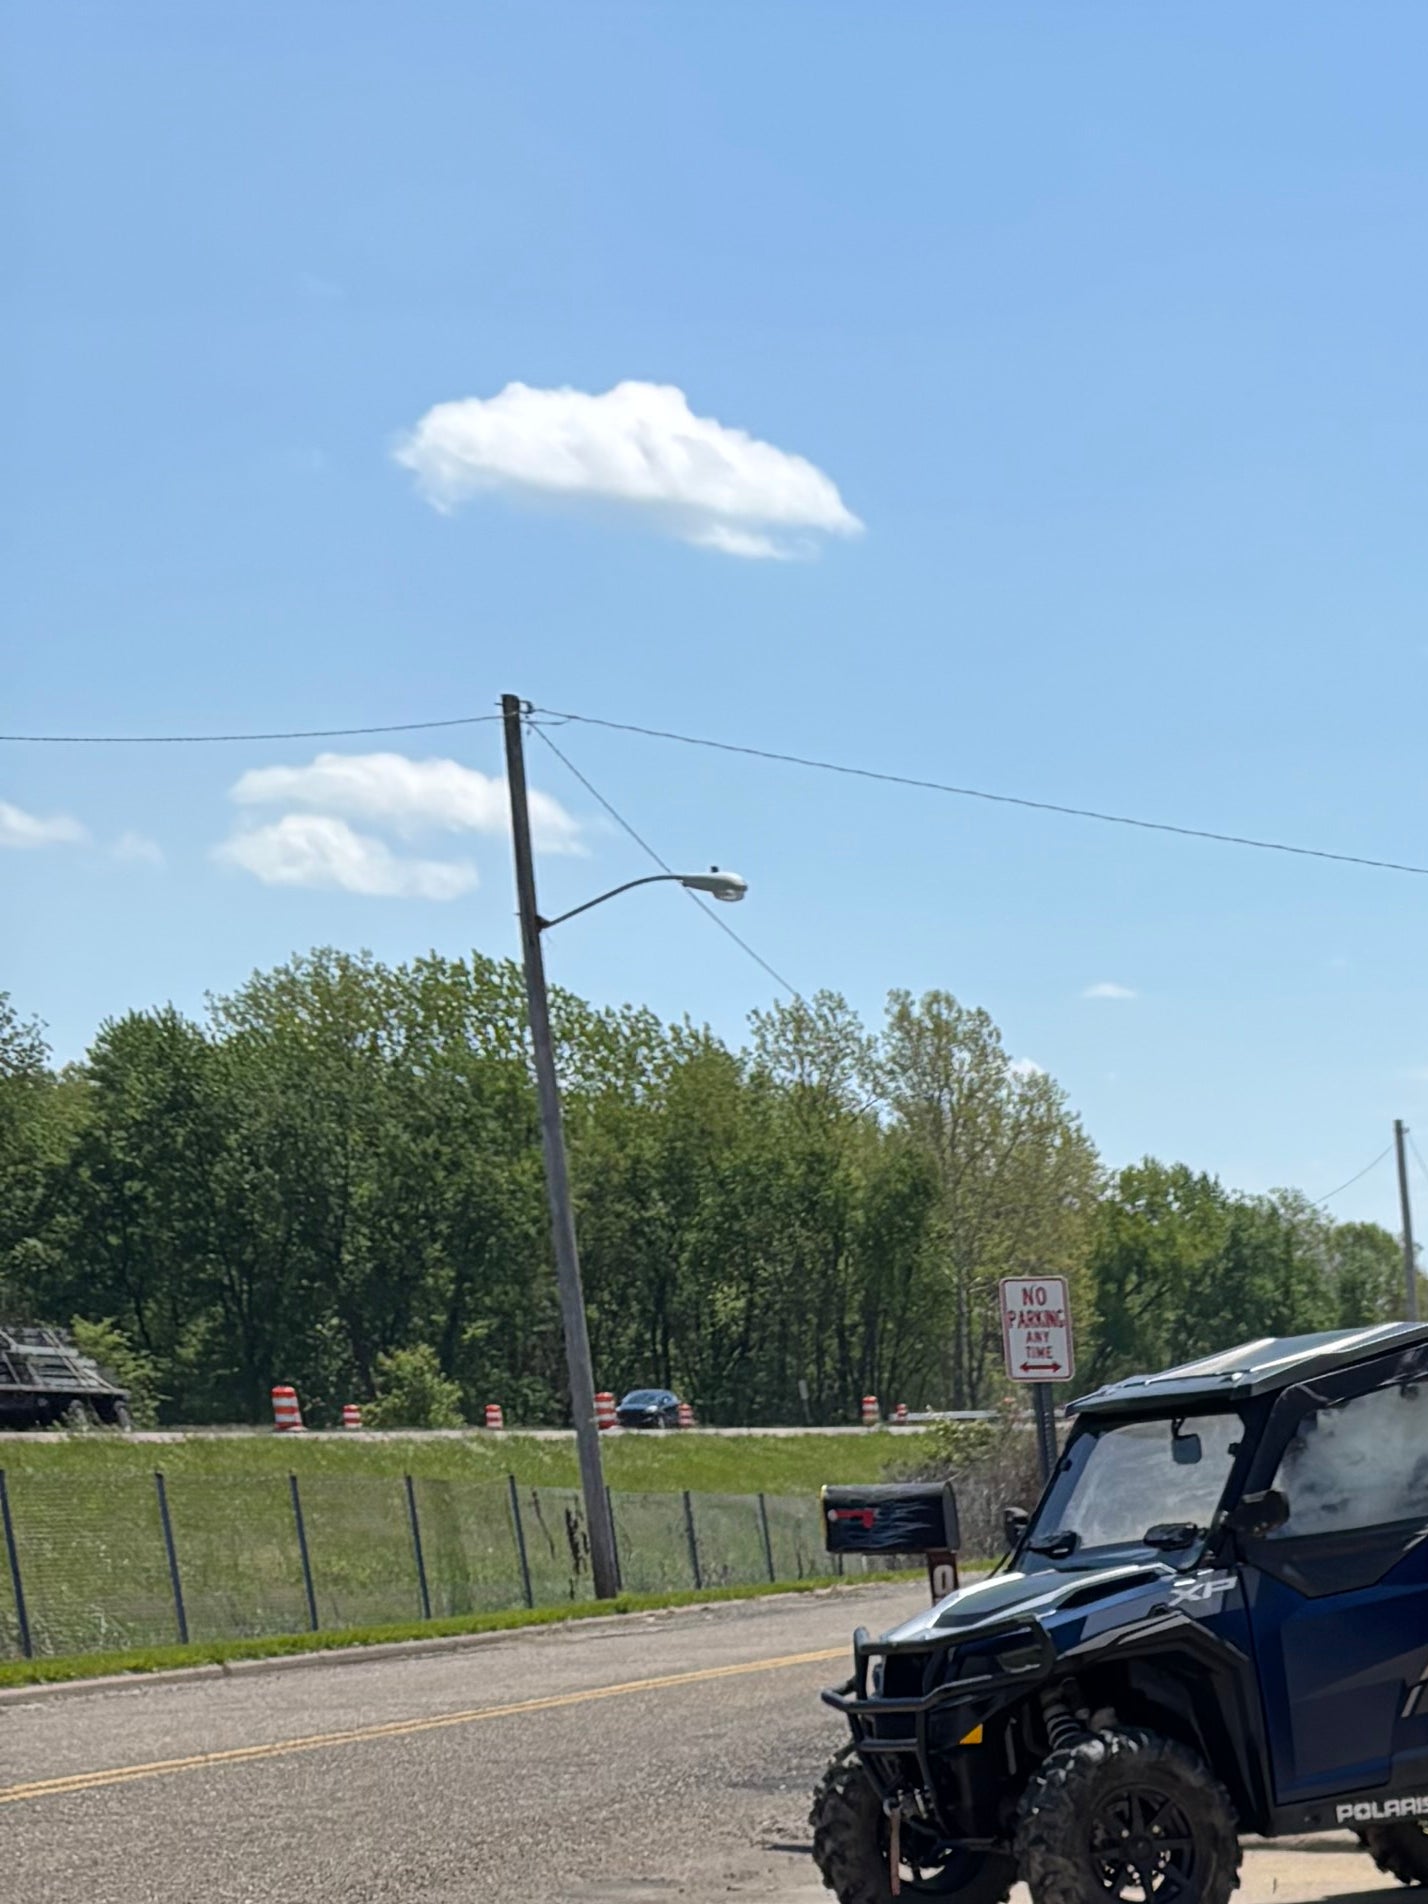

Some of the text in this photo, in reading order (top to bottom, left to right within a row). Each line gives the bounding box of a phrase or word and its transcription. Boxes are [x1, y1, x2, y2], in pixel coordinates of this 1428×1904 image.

[1022, 1286, 1047, 1306] NO
[1007, 1309, 1065, 1328] PARKING
[1026, 1331, 1050, 1343] ANY
[1026, 1345, 1053, 1359] TIME
[1168, 1576, 1238, 1607] XP
